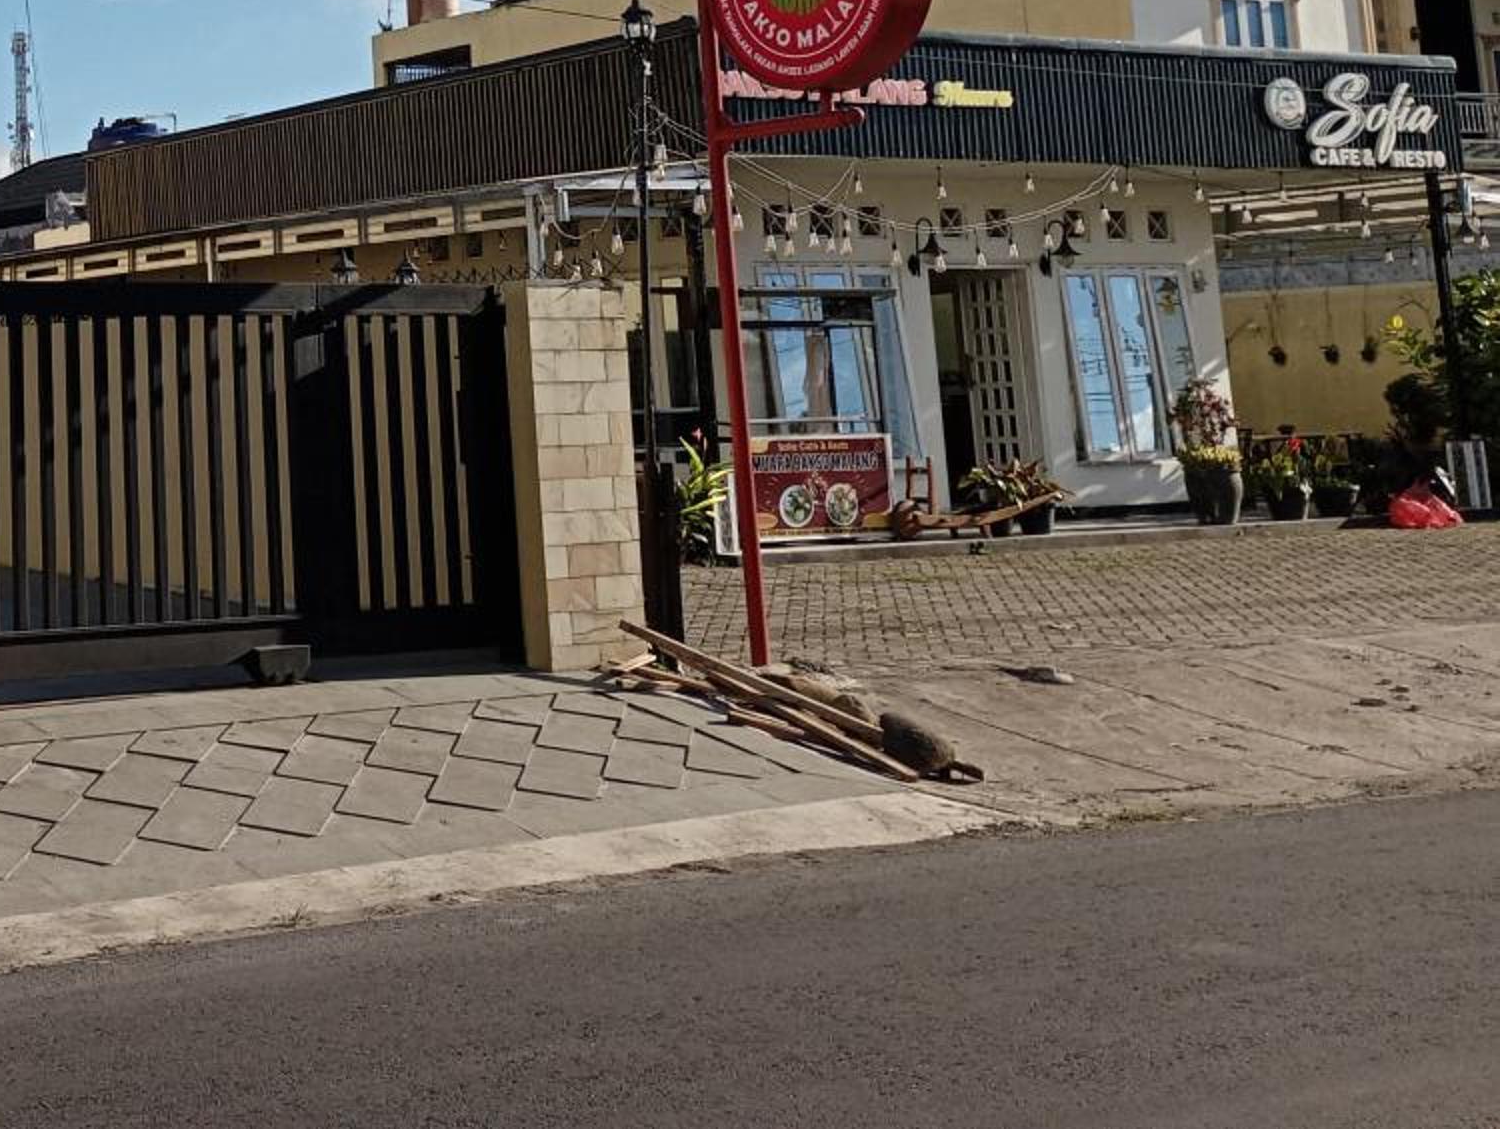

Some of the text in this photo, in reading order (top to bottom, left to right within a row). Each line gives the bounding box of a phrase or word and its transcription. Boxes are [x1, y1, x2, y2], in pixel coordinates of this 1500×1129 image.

[1305, 72, 1439, 164] Sofia
[1311, 147, 1447, 168] CAFE & RESTO
